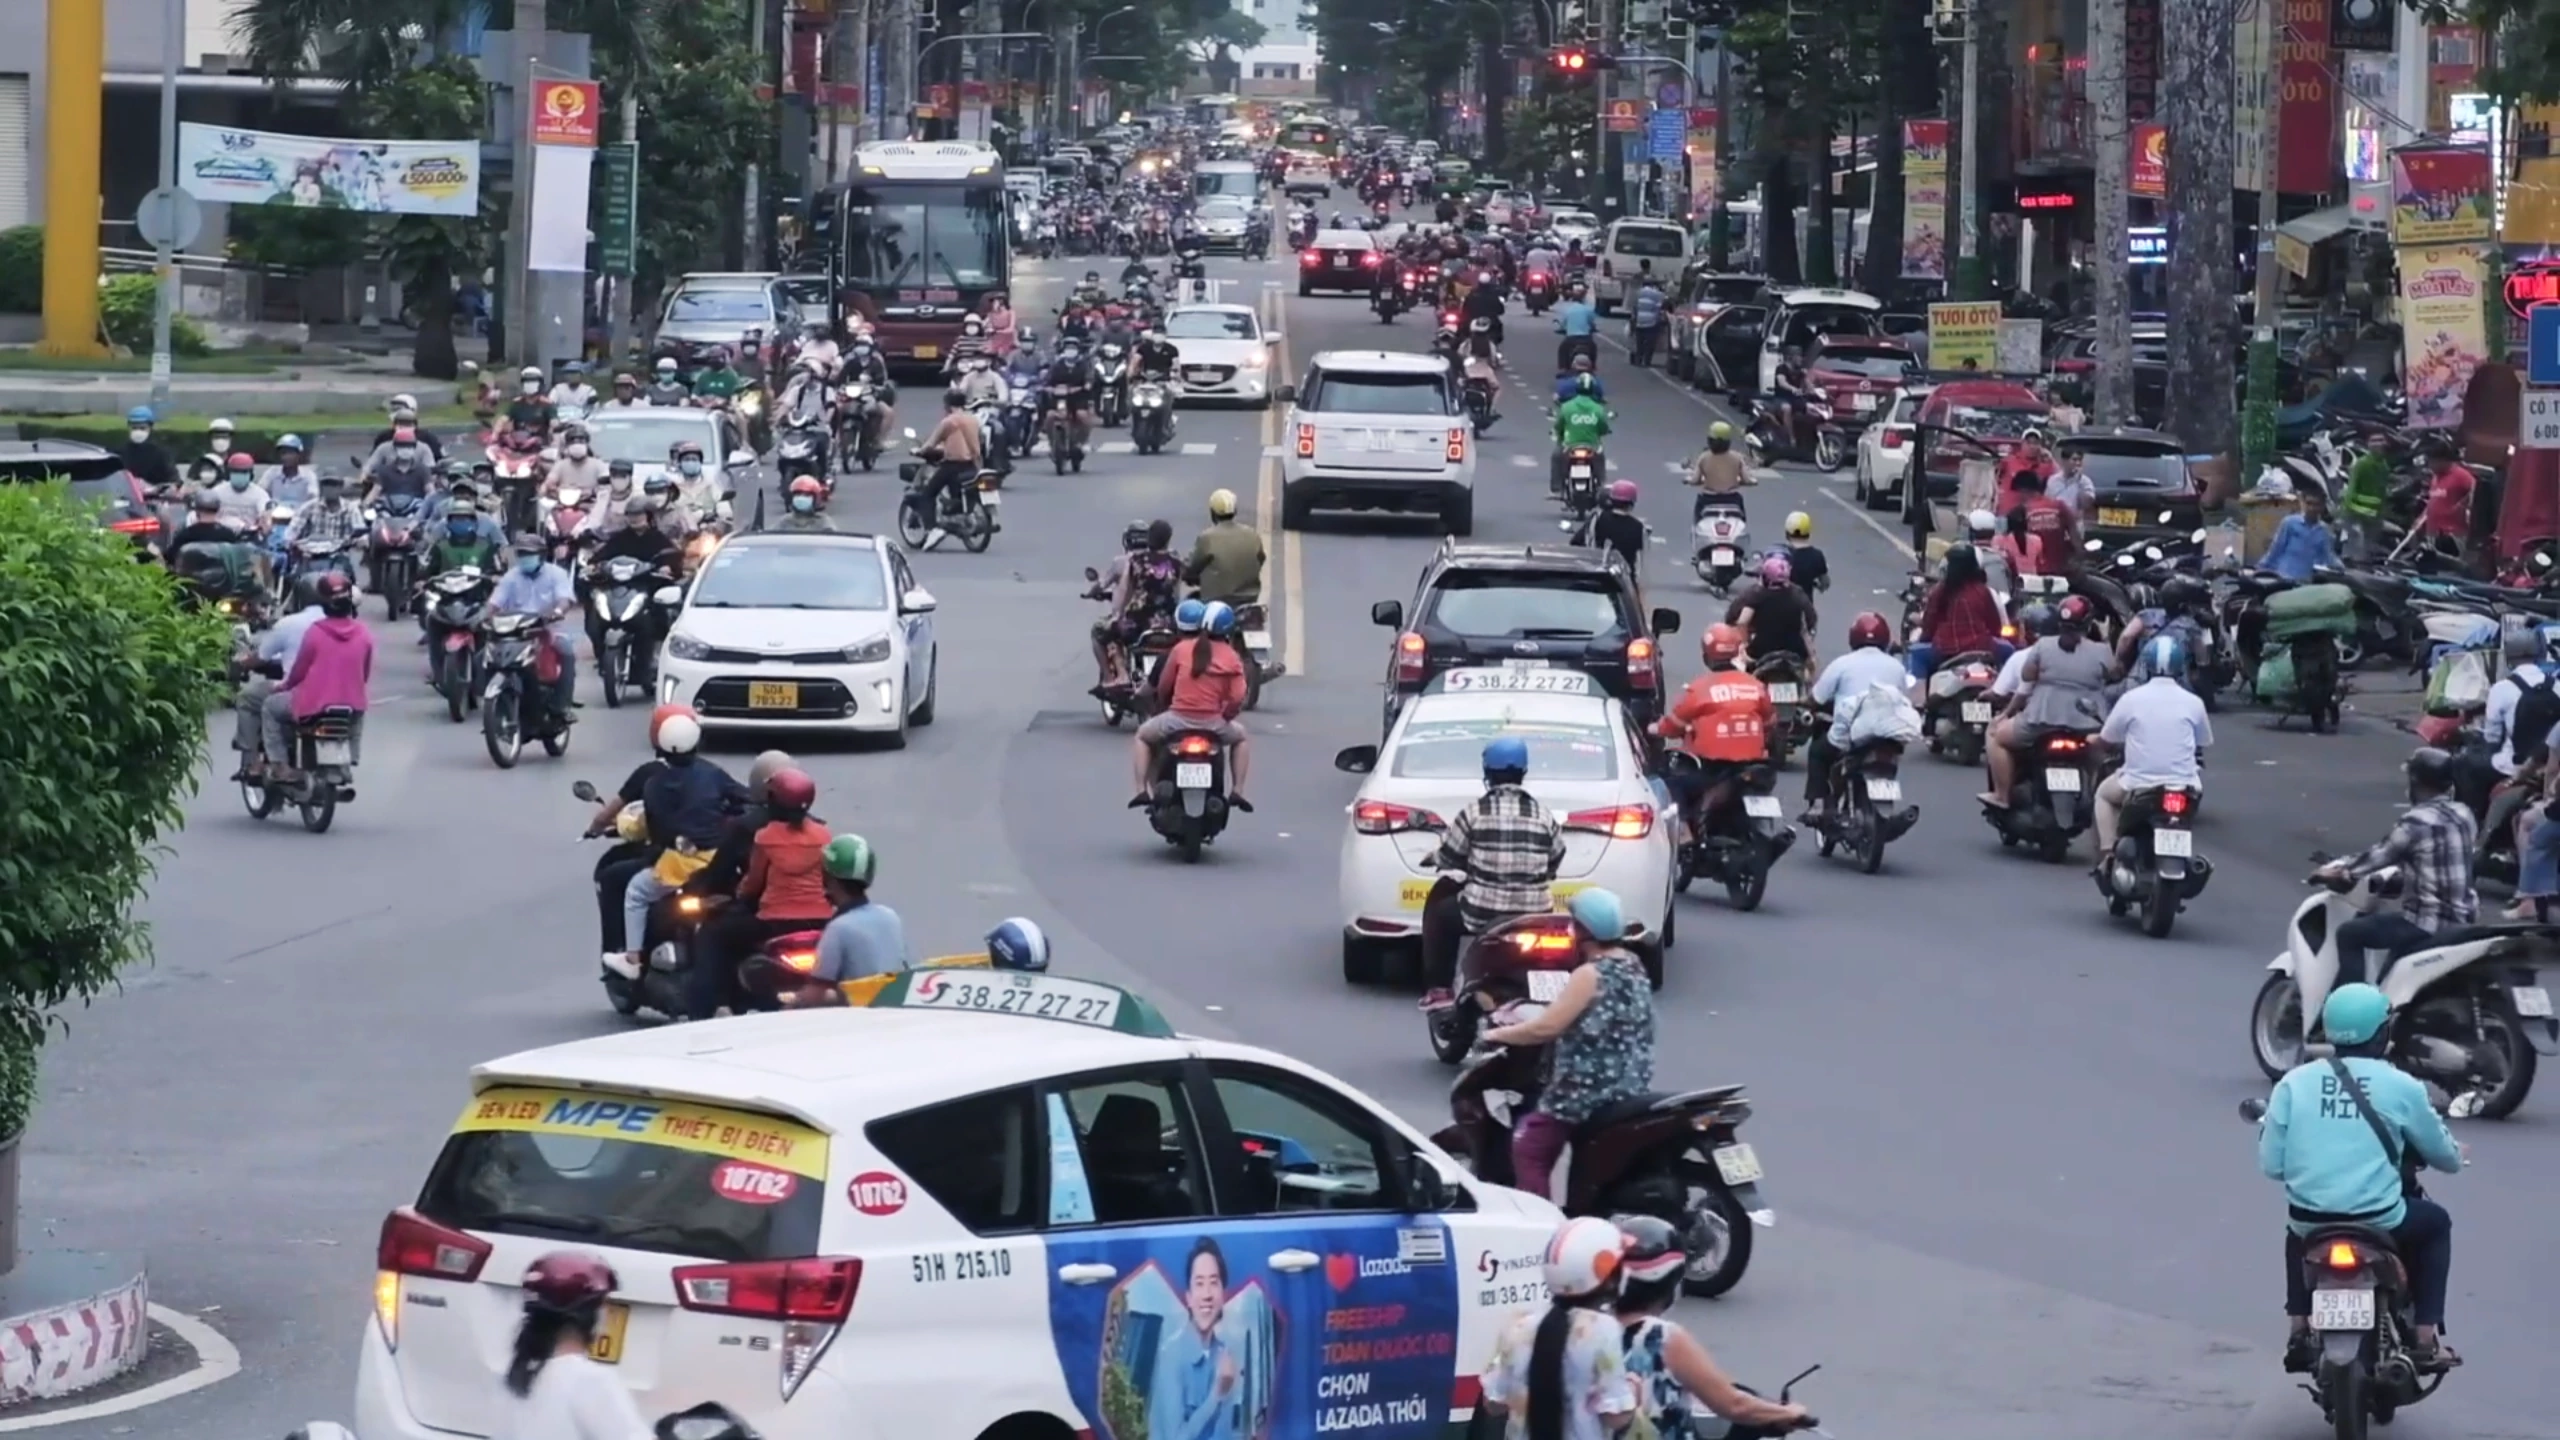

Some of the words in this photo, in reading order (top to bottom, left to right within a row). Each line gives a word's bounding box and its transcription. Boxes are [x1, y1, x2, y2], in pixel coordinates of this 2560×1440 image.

[1571, 412, 1598, 425] Grab
[2529, 397, 2546, 415] CÓ
[1477, 676, 1530, 689] 38.27
[1536, 677, 1556, 689] 27
[1562, 677, 1585, 690] 27
[956, 984, 1032, 1012] 38.27
[1036, 992, 1072, 1017] 27
[1075, 998, 1110, 1022] 27
[2320, 1097, 2361, 1119] MI
[508, 1101, 541, 1121] LED
[542, 1098, 663, 1133] MPE
[662, 1114, 717, 1141] THIẾT
[719, 1126, 742, 1151] BỊ
[744, 1131, 795, 1158] ĐIỆN
[722, 1165, 789, 1198] 10762
[850, 1180, 904, 1208] 10762
[912, 1252, 946, 1282] 51H
[955, 1248, 1011, 1281] 215.10
[1325, 1304, 1406, 1332] FREESHIP
[1317, 1371, 1370, 1401] CHỌN
[1315, 1401, 1385, 1432] LAZADA
